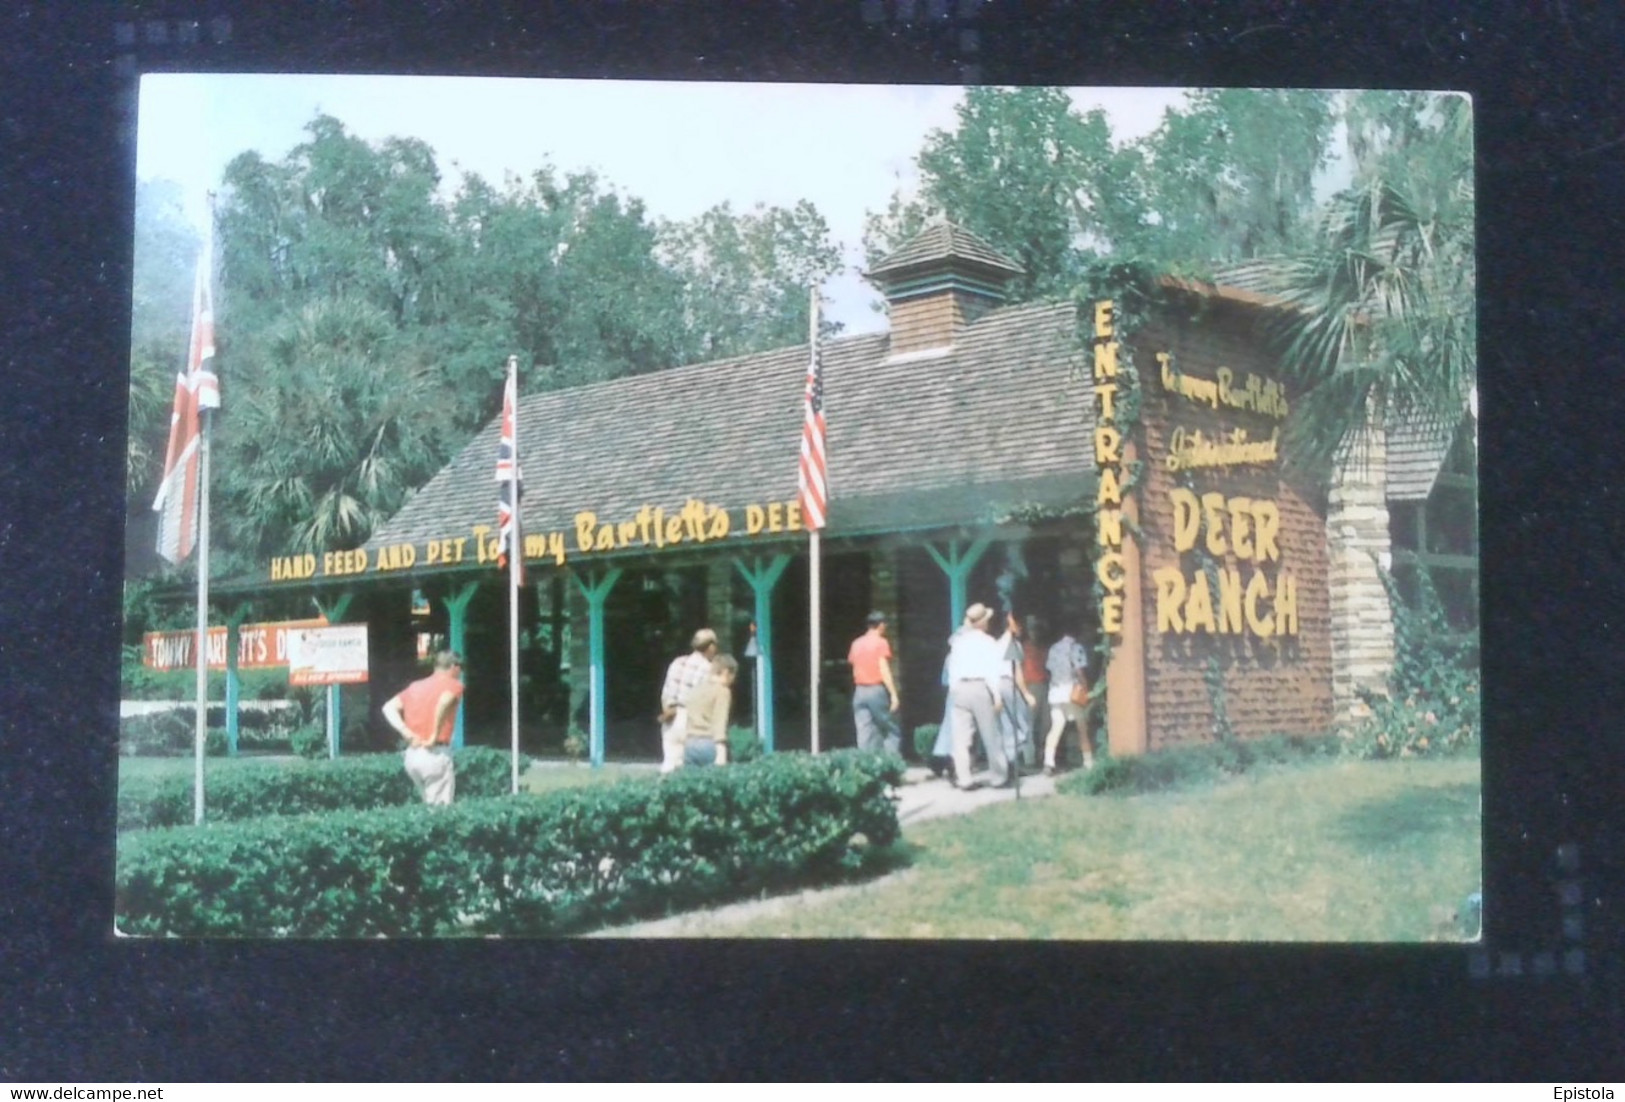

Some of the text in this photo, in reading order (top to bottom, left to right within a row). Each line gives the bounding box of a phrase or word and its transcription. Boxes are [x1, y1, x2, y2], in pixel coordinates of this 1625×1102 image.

[1094, 300, 1124, 634] ENTRANCE
[271, 498, 801, 580] HAND FEED AND PET Tomy Bartlett's DEE
[1170, 488, 1279, 562] DEER
[1153, 567, 1299, 637] RANCH
